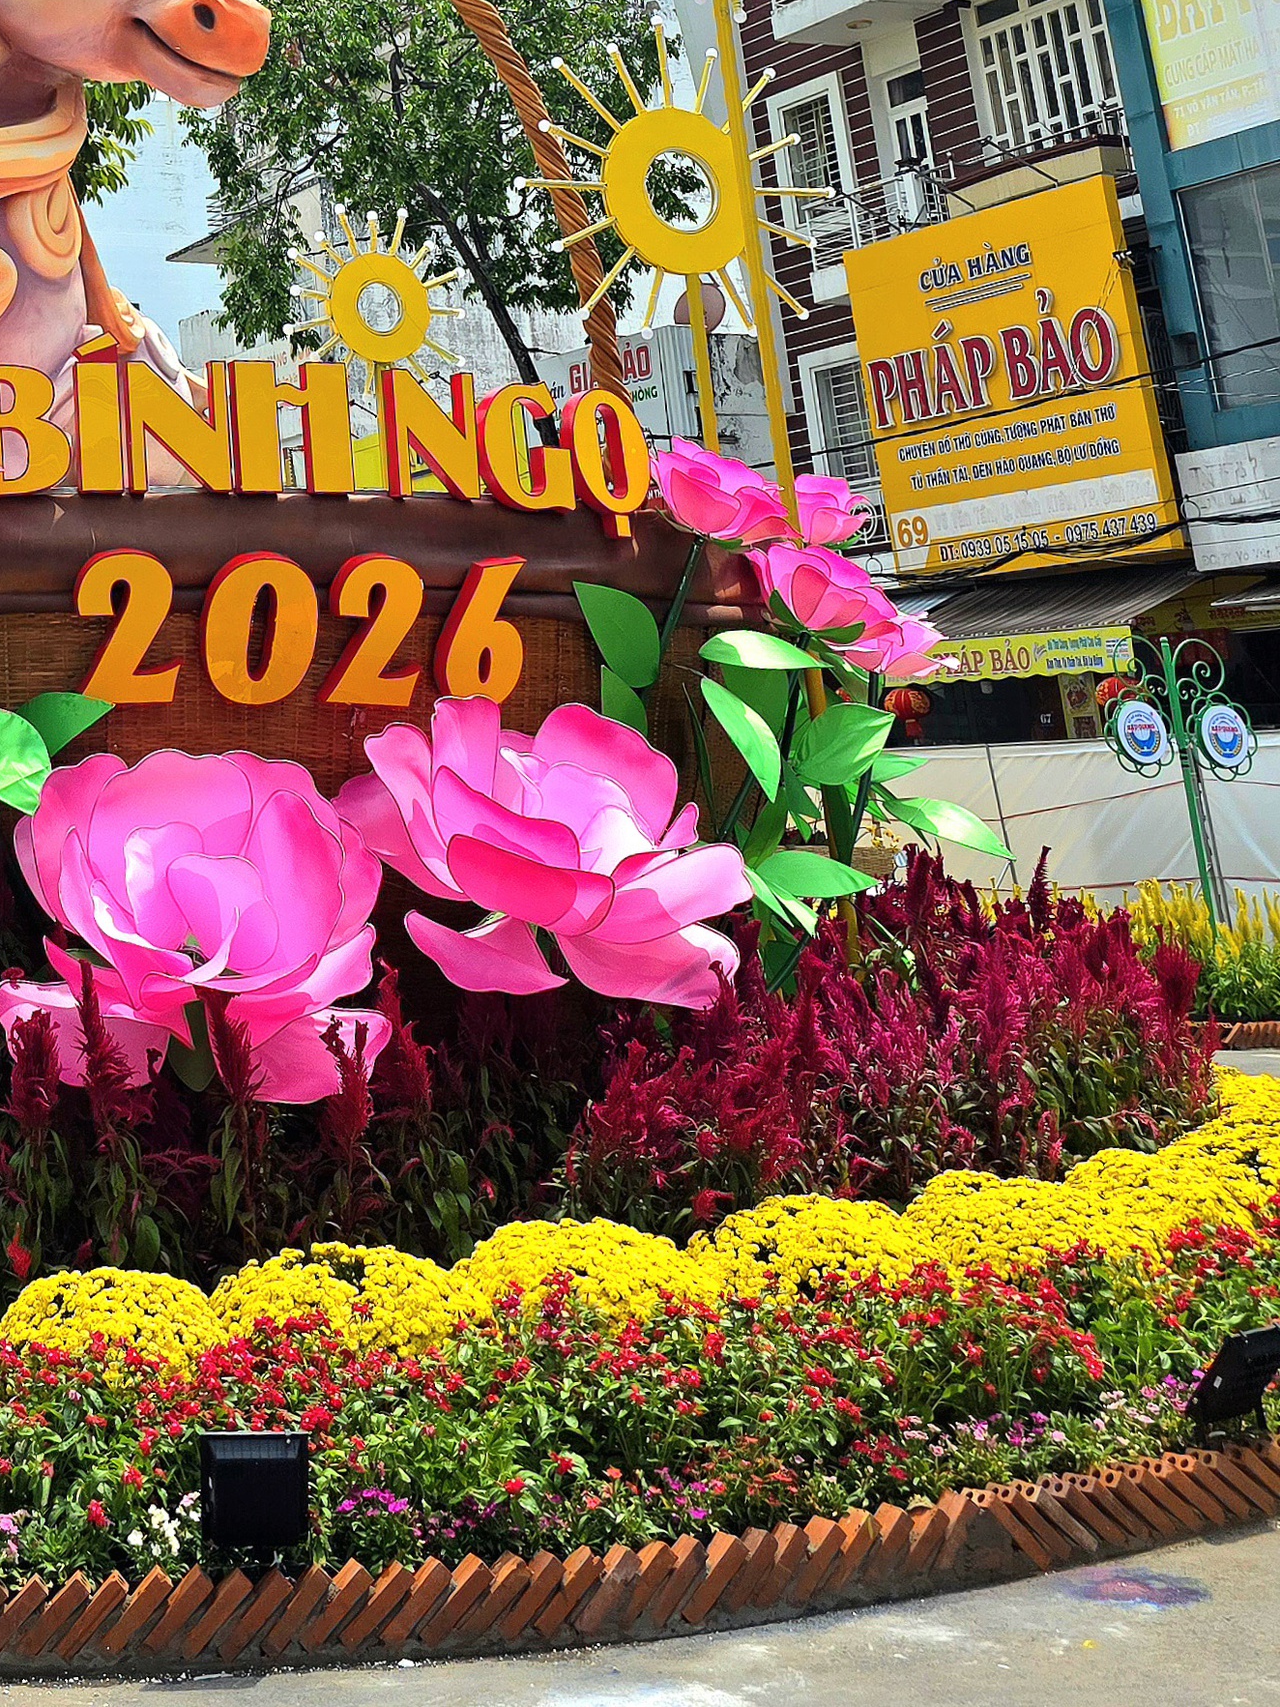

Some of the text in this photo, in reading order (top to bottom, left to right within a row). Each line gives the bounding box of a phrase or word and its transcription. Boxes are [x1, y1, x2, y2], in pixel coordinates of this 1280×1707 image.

[919, 242, 1032, 293] CỬA HÀNG
[568, 341, 652, 394] GI ẢO
[867, 287, 1119, 430] PHÁP BẢO
[383, 368, 651, 538] NGỌ
[898, 441, 935, 462] CHUYÊN
[953, 432, 972, 451] THỜ
[1040, 414, 1066, 434] PHẬT
[1069, 409, 1092, 429] BÀN
[1094, 403, 1117, 422] THỜ
[972, 462, 993, 480] ĐÈN
[995, 456, 1015, 476] HÀO
[1057, 446, 1072, 466] BỘ
[897, 515, 929, 548] 69
[961, 538, 992, 559] 0939
[995, 535, 1012, 554] 05
[1013, 532, 1029, 551] 15
[1032, 530, 1049, 549] 05
[1065, 522, 1099, 543] 0975
[1102, 517, 1126, 538] 437
[1130, 512, 1157, 533] 439
[73, 548, 527, 707] 2026
[989, 639, 1032, 674] BẢO
